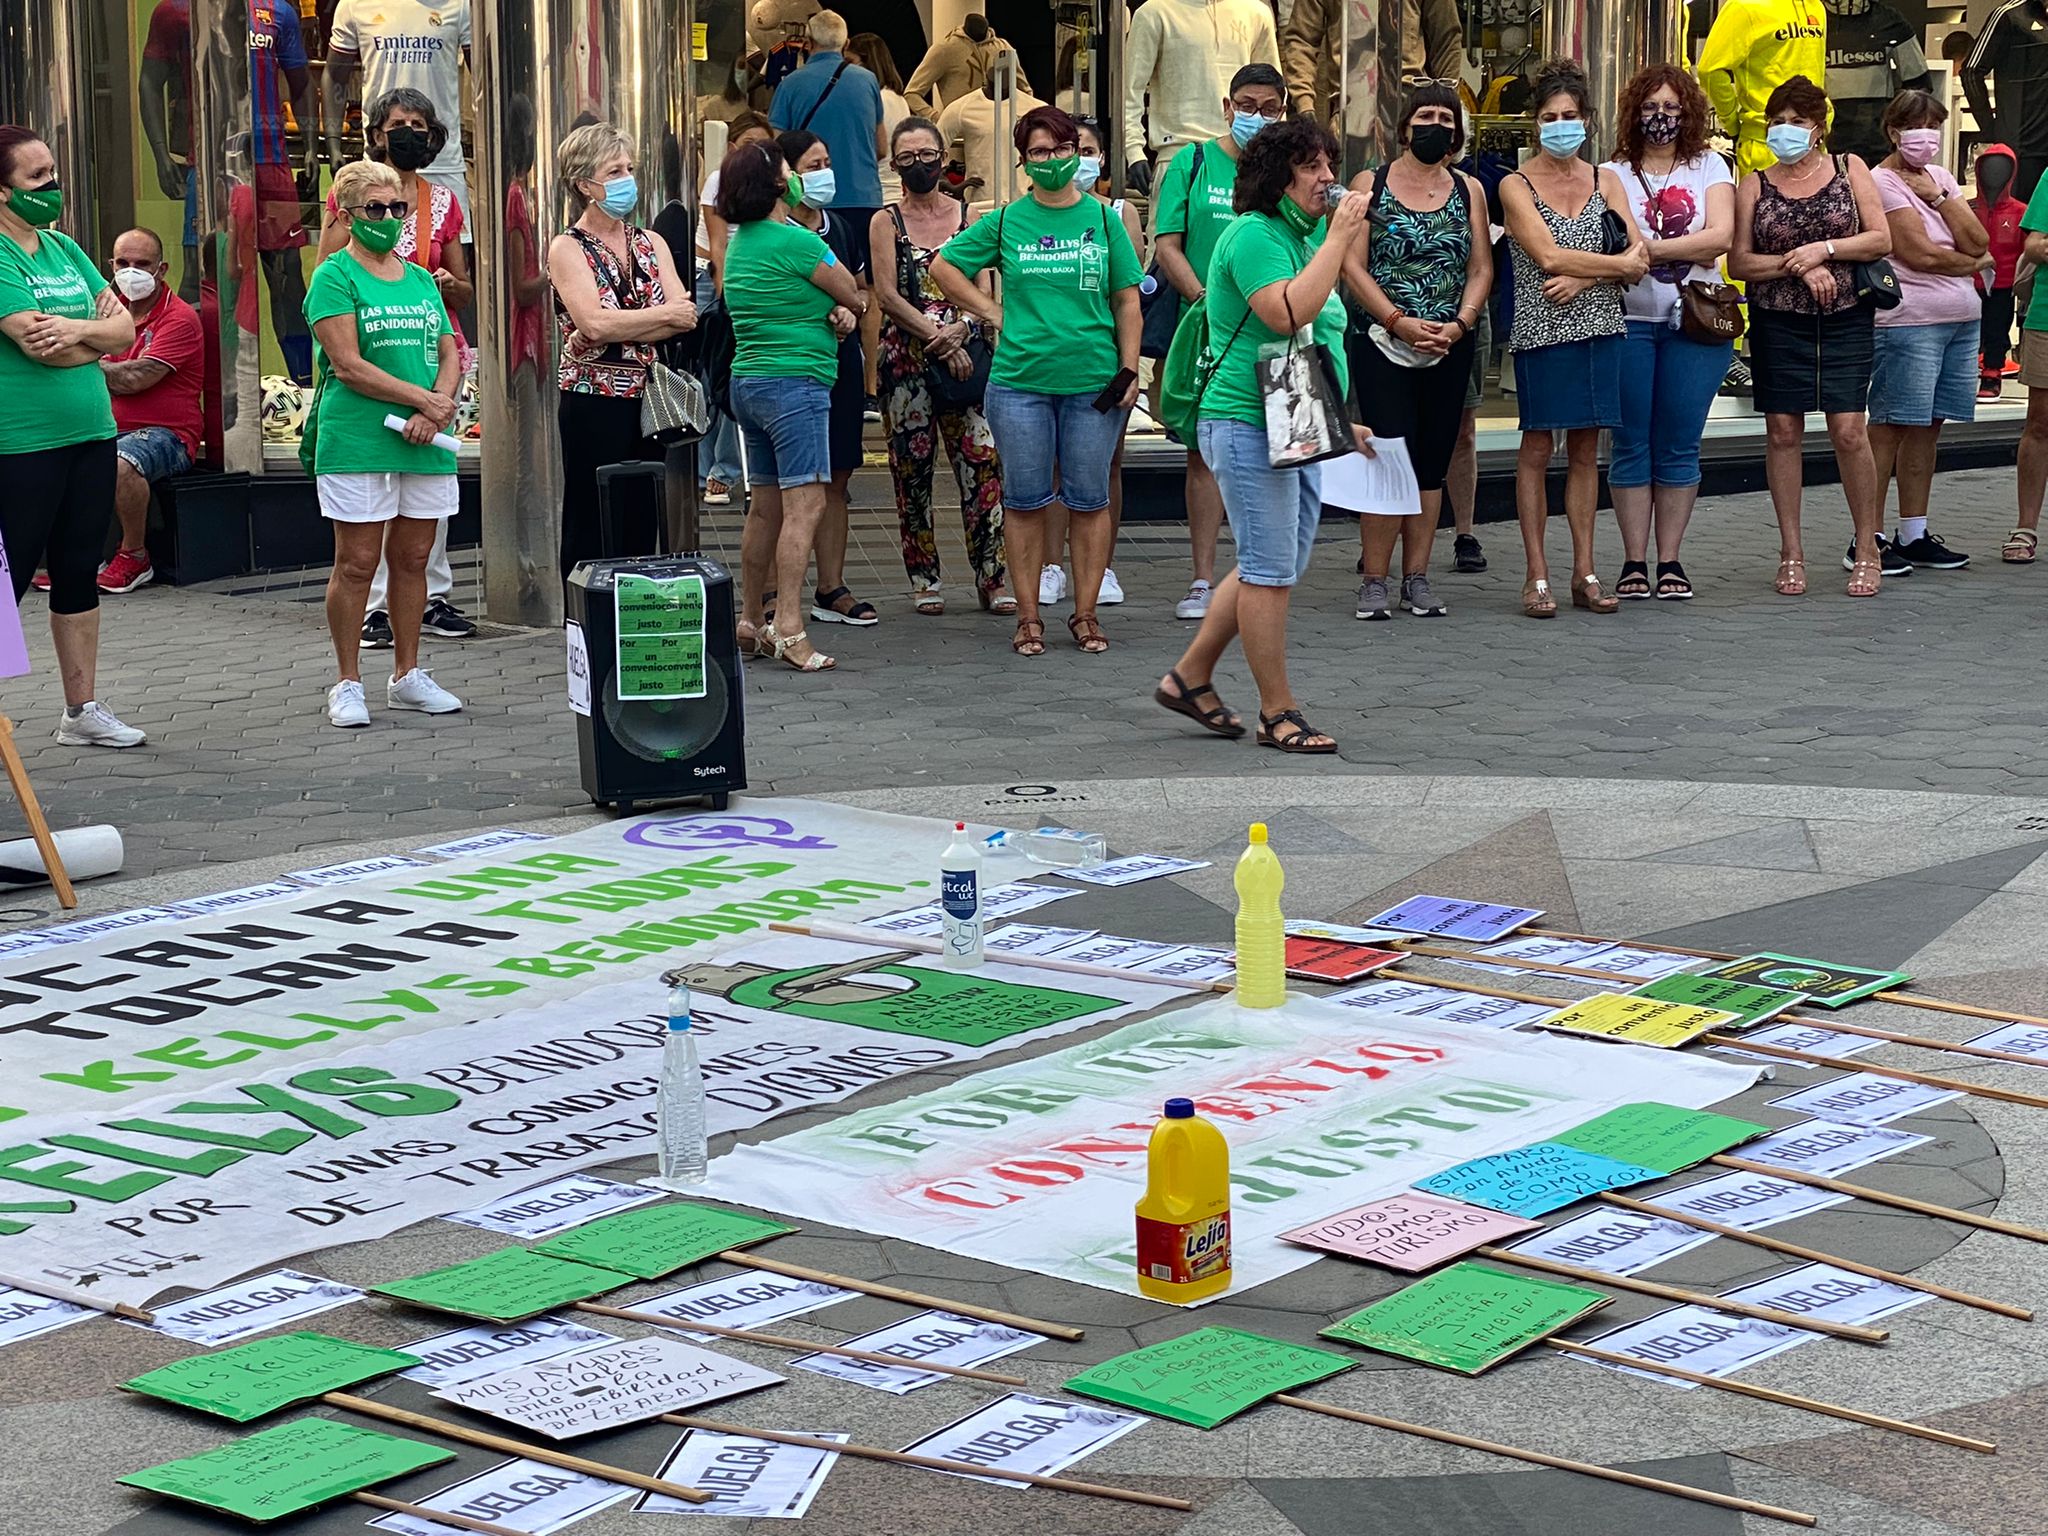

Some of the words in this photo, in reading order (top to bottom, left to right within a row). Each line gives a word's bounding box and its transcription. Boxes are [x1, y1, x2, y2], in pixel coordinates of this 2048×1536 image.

[373, 35, 443, 50] Emirates
[385, 51, 398, 63] FLY
[400, 51, 433, 63] BETTER
[1207, 184, 1226, 195] LAS
[1018, 243, 1037, 252] LAS
[1040, 239, 1080, 252] KLLYS
[1019, 251, 1078, 262] BENIDORM
[26, 275, 42, 286] LAS
[1022, 266, 1051, 274] MARINA
[33, 286, 84, 299] BENIDORM
[361, 305, 382, 319] LAS
[386, 303, 425, 315] KELLYS
[365, 318, 424, 333] BENIDORM
[1713, 317, 1734, 332] LOVE
[372, 337, 401, 348] MARINA
[401, 338, 421, 346] BAIXA
[618, 579, 634, 588] Por
[619, 602, 662, 612] convenio
[637, 619, 662, 629] justo
[679, 618, 703, 628] justo
[620, 638, 636, 648] Por
[662, 638, 678, 647] Por
[645, 653, 657, 661] un
[687, 651, 699, 659] un
[620, 662, 663, 672] convenio
[638, 680, 664, 691] justo
[681, 678, 704, 690] justo
[693, 765, 726, 777] Sytech
[442, 836, 525, 856] HUELGA
[312, 861, 400, 883] HUELGA
[200, 888, 286, 912] HUELGA
[291, 899, 415, 926] A
[388, 853, 622, 902] UNA
[1429, 903, 1489, 933] convenio
[1440, 903, 1458, 913] un
[1484, 907, 1525, 926] justo
[69, 912, 166, 936] HUELGA
[1376, 912, 1408, 927] Por
[986, 931, 1045, 950] UELGA
[0, 943, 431, 1040] TOCAN
[394, 921, 520, 948] A
[1692, 981, 1717, 994] un
[1340, 986, 1428, 1008] HUELGA
[1621, 1001, 1648, 1013] un
[1737, 988, 1786, 1011] justo
[1440, 998, 1524, 1024] HUELGA
[1550, 1011, 1585, 1027] Por
[1606, 1003, 1681, 1036] convenio
[1667, 1008, 1719, 1030] justo
[39, 973, 531, 1094] KELLYS
[425, 1007, 753, 1096] BENIDORM
[1811, 1081, 1912, 1112] HUELGA
[848, 1087, 1080, 1153] POR
[922, 1042, 1447, 1210] CONENIO
[105, 1197, 252, 1238] POR
[286, 1139, 458, 1184] UNAS
[467, 1042, 820, 1136] CONDICNES
[286, 1191, 405, 1227] DE
[705, 1045, 956, 1113] DIGNAS
[1760, 1129, 1867, 1162] HUELGA
[483, 1186, 604, 1224] HUELGA
[1686, 1180, 1796, 1215] HUELGA
[1299, 1203, 1410, 1244] TOD@S
[1354, 1208, 1452, 1246] SOMOS
[1186, 1219, 1227, 1259] Lejía
[1544, 1221, 1651, 1263] HUELGA
[167, 1286, 302, 1326] HUELGA
[659, 1282, 800, 1323] HUELGA
[421, 1328, 553, 1373] HUELGA
[840, 1328, 979, 1373] HELGA
[1619, 1320, 1743, 1363] HUELGA
[533, 1344, 662, 1383] AYUDAS
[523, 1361, 717, 1423] imposibilidad
[942, 1413, 1076, 1467] HUELGA
[693, 1444, 781, 1504] HUELGA
